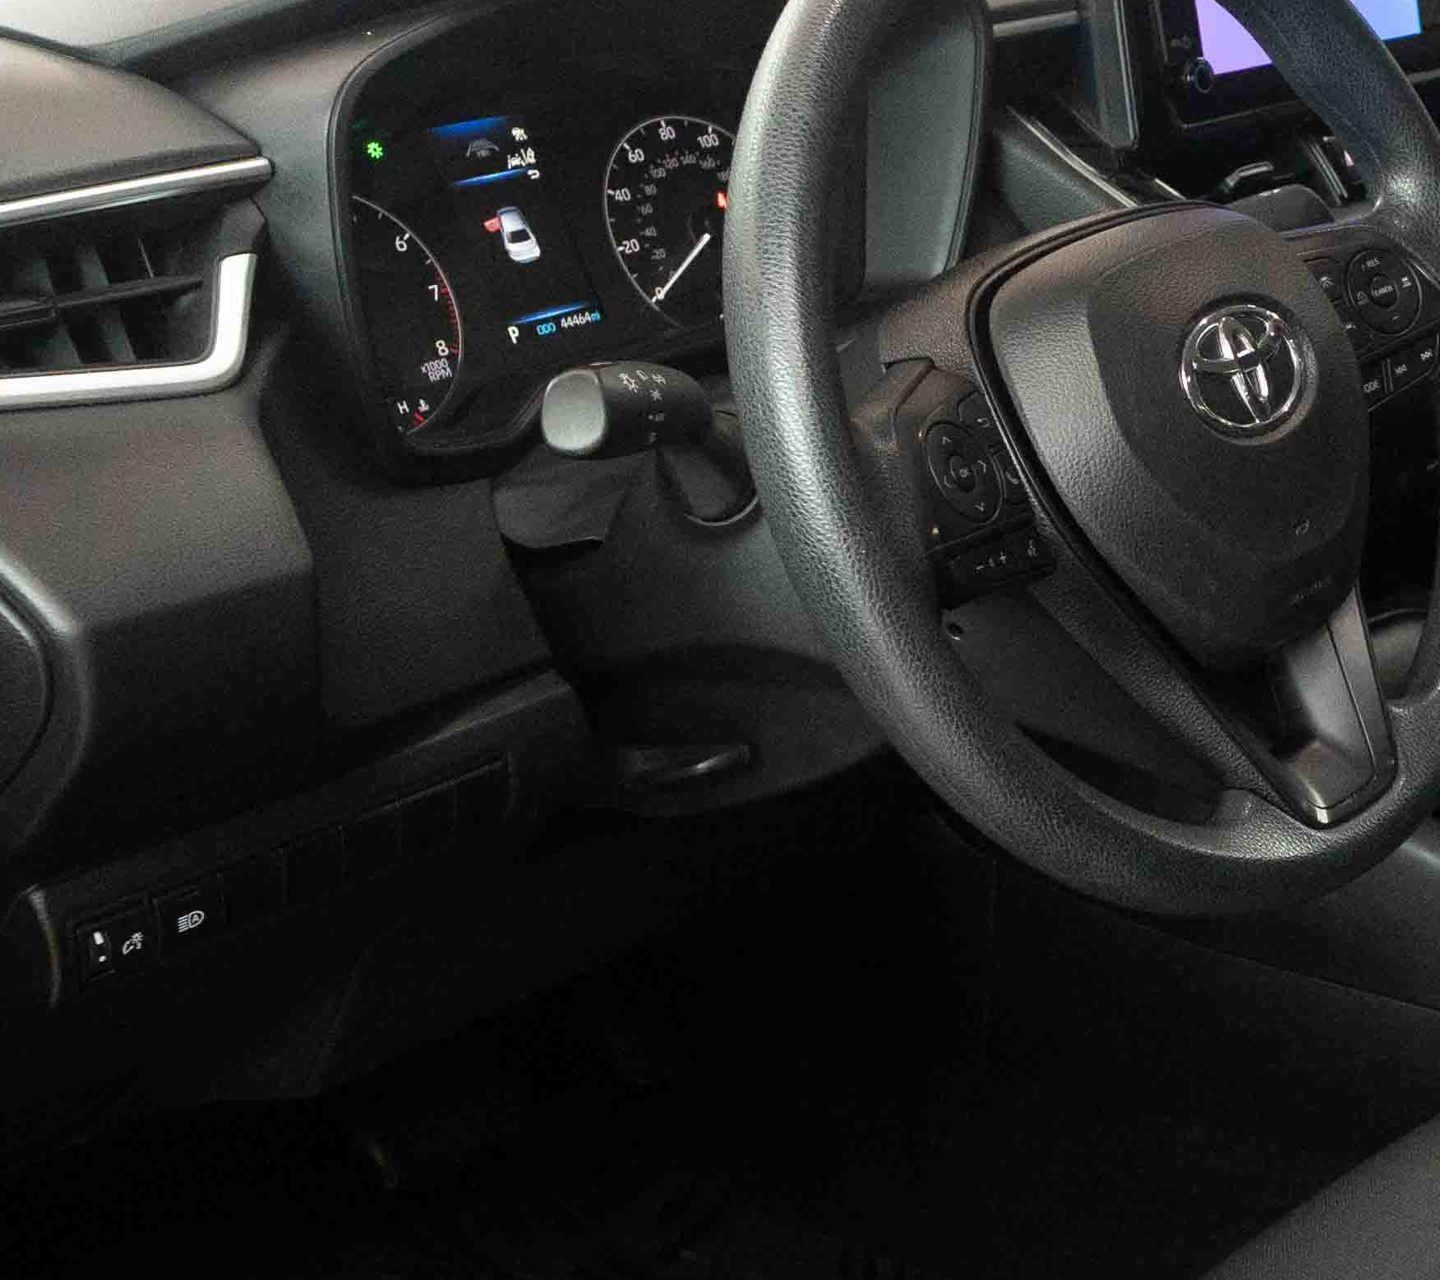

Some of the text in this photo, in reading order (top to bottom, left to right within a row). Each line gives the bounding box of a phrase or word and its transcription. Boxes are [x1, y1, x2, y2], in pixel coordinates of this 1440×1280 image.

[658, 126, 676, 141] 80
[697, 133, 720, 149] 100
[628, 148, 645, 163] 60
[614, 188, 631, 202] 40
[394, 235, 408, 252] 6
[622, 238, 640, 254] 20
[427, 284, 440, 302] 7
[507, 325, 520, 344] P
[435, 340, 450, 357] 8
[428, 368, 453, 384] RPM
[396, 401, 410, 415] H
